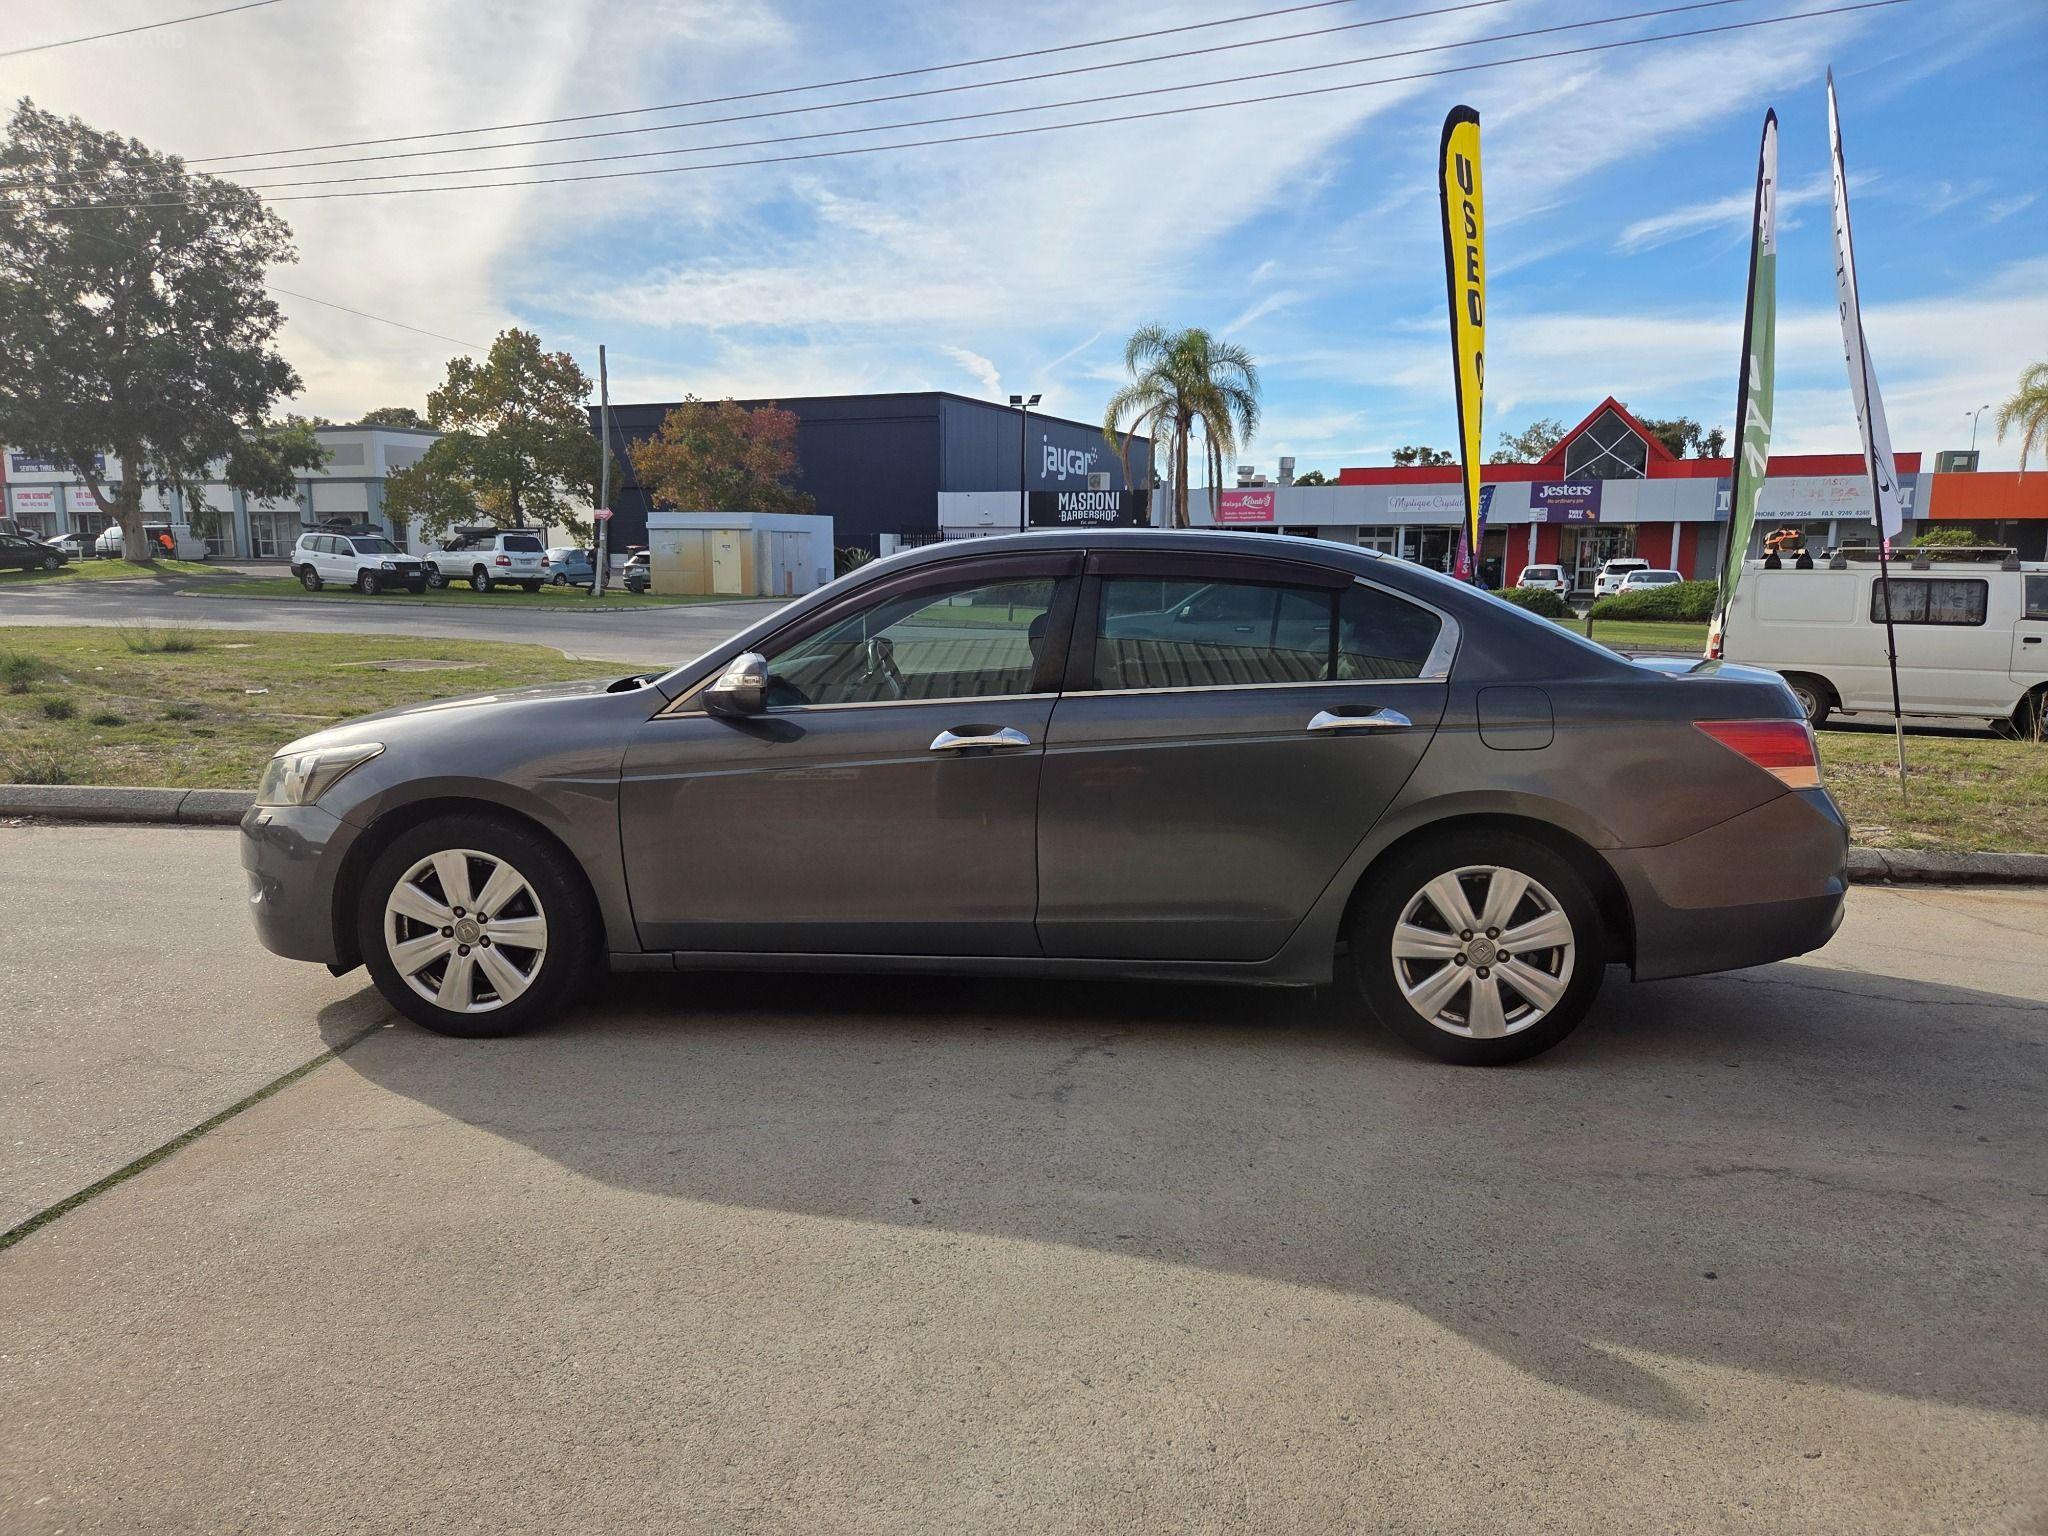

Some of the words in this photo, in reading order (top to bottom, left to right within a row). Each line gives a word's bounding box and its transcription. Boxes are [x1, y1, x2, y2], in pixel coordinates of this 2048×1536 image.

[1455, 153, 1482, 328] USED
[1041, 434, 1091, 480] jaycar
[1539, 484, 1593, 498] Jesters
[1058, 491, 1120, 511] MASRONI
[1390, 497, 1432, 511] Mystique
[1061, 510, 1117, 521] BARBERSHOP
